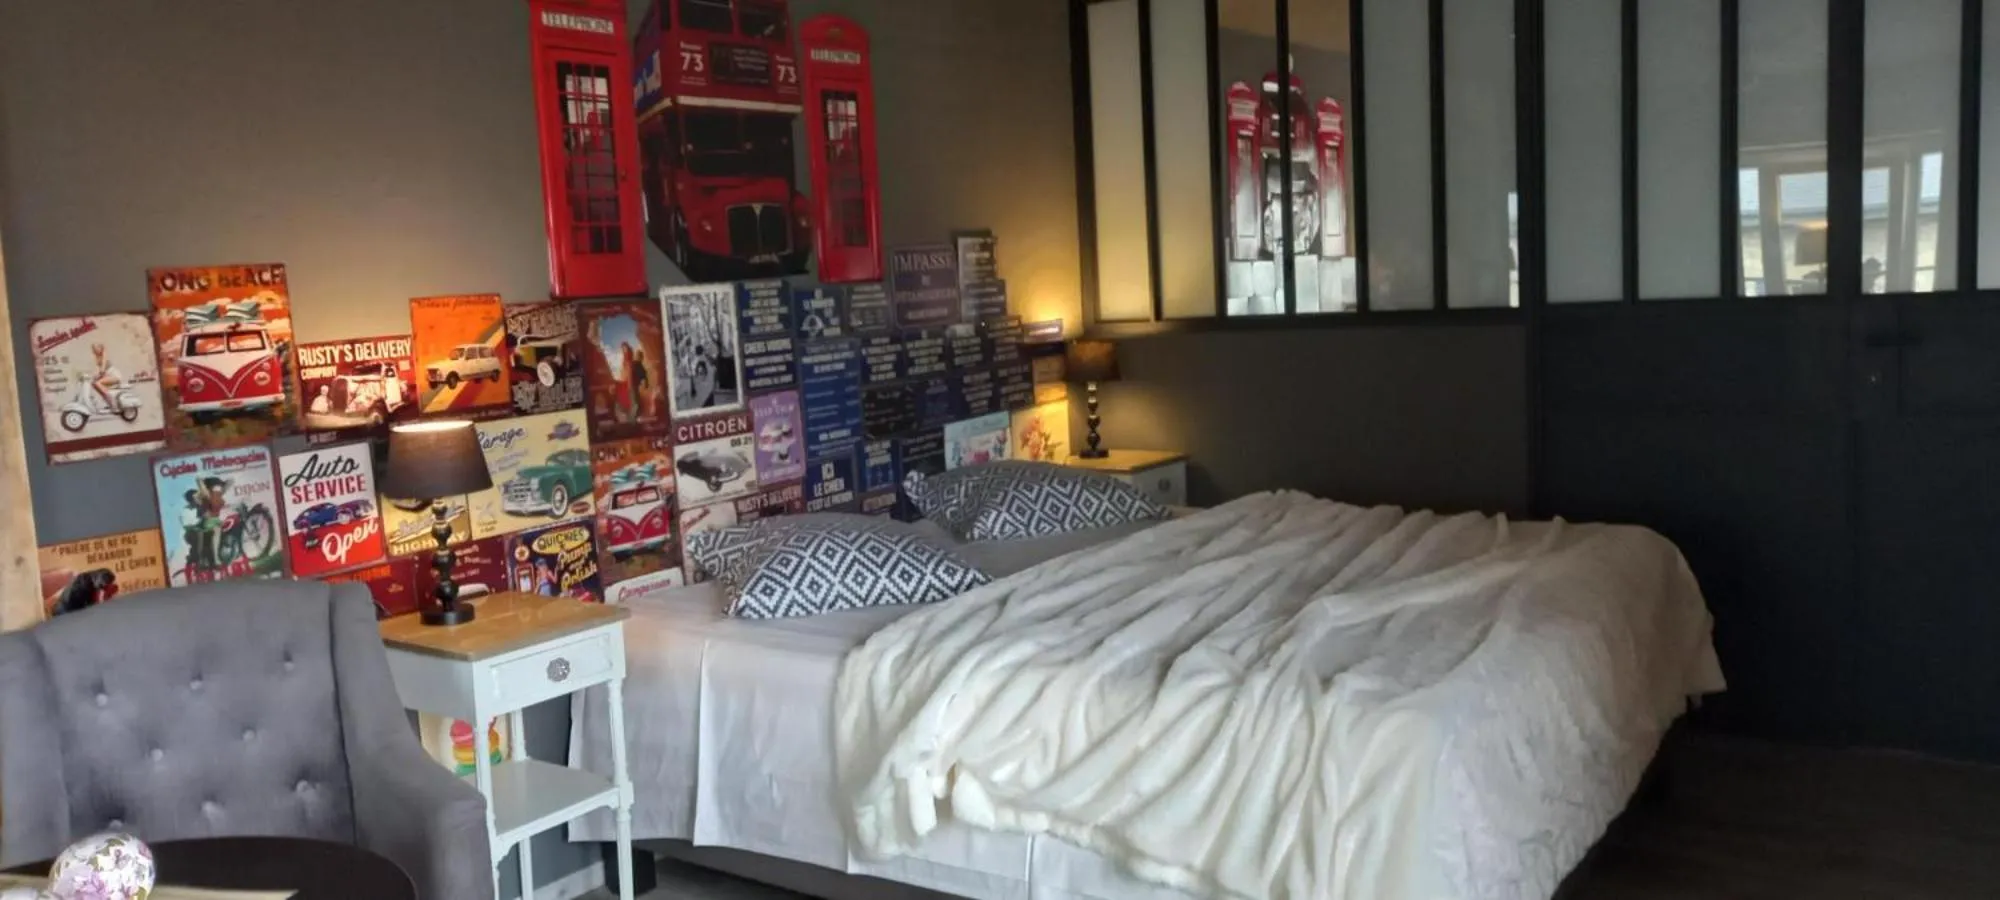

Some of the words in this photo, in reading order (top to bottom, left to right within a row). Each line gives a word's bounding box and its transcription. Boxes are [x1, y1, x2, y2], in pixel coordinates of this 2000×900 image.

[680, 52, 704, 72] 73
[777, 64, 797, 83] 73
[298, 343, 354, 366] RUSTY'S
[354, 337, 412, 361] DELIVERY
[285, 453, 360, 487] Auto
[291, 473, 367, 505] SERVICE
[322, 517, 378, 565] Open
